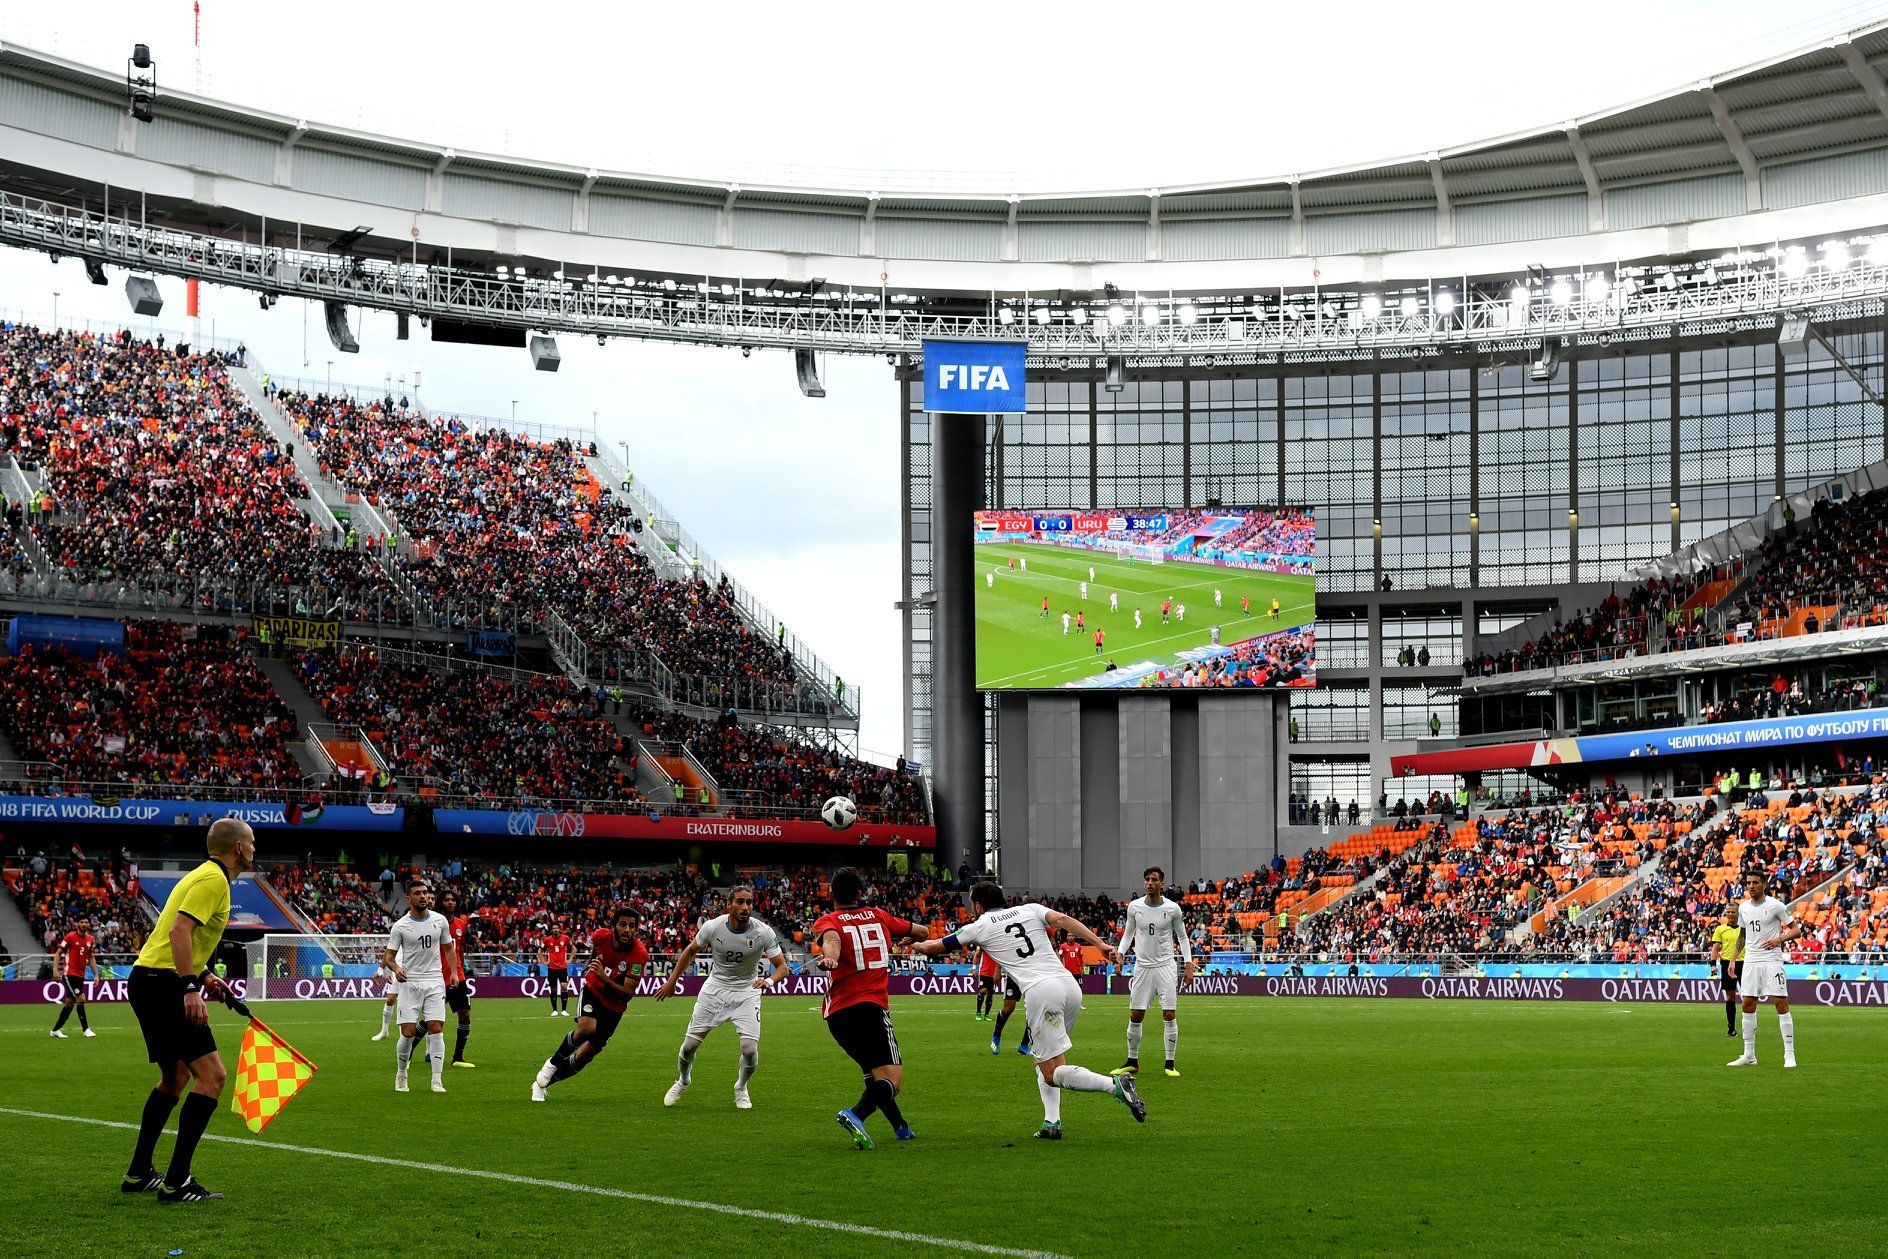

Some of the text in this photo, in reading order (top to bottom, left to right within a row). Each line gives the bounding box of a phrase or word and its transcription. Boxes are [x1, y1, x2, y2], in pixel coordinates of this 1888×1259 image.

[940, 365, 1010, 390] FIFA
[1005, 518, 1027, 529] EGY
[1040, 518, 1066, 529] 0 0
[1078, 518, 1102, 529] URU
[1133, 519, 1161, 529] 38:47
[1225, 561, 1276, 572] QATAR AIRWAYS
[1668, 731, 1742, 750] ЧЕМПИОНАТ
[1745, 727, 1783, 743] МИРА
[1785, 725, 1804, 739] ПО
[1807, 719, 1869, 737] ФУТБОЛУ
[0, 803, 160, 819] 18 FIFA WORLD CUP
[228, 809, 286, 824] RUSSIA
[687, 823, 782, 837] EKATERINBURG
[1148, 923, 1155, 935] 6
[1749, 919, 1761, 932] 15
[417, 935, 432, 949] 10
[842, 923, 889, 970] 19
[1005, 923, 1035, 958] 3
[80, 947, 85, 956] 2
[726, 951, 744, 963] 22
[911, 977, 975, 995] QATAR
[1775, 973, 1785, 985] 15
[43, 981, 129, 1005] QTAR
[295, 978, 374, 998] QATAR
[1267, 977, 1388, 996] QATAR AIRWAYS
[1422, 978, 1563, 999] QATAR AIRWAYS
[1601, 979, 1670, 1002] QATAR
